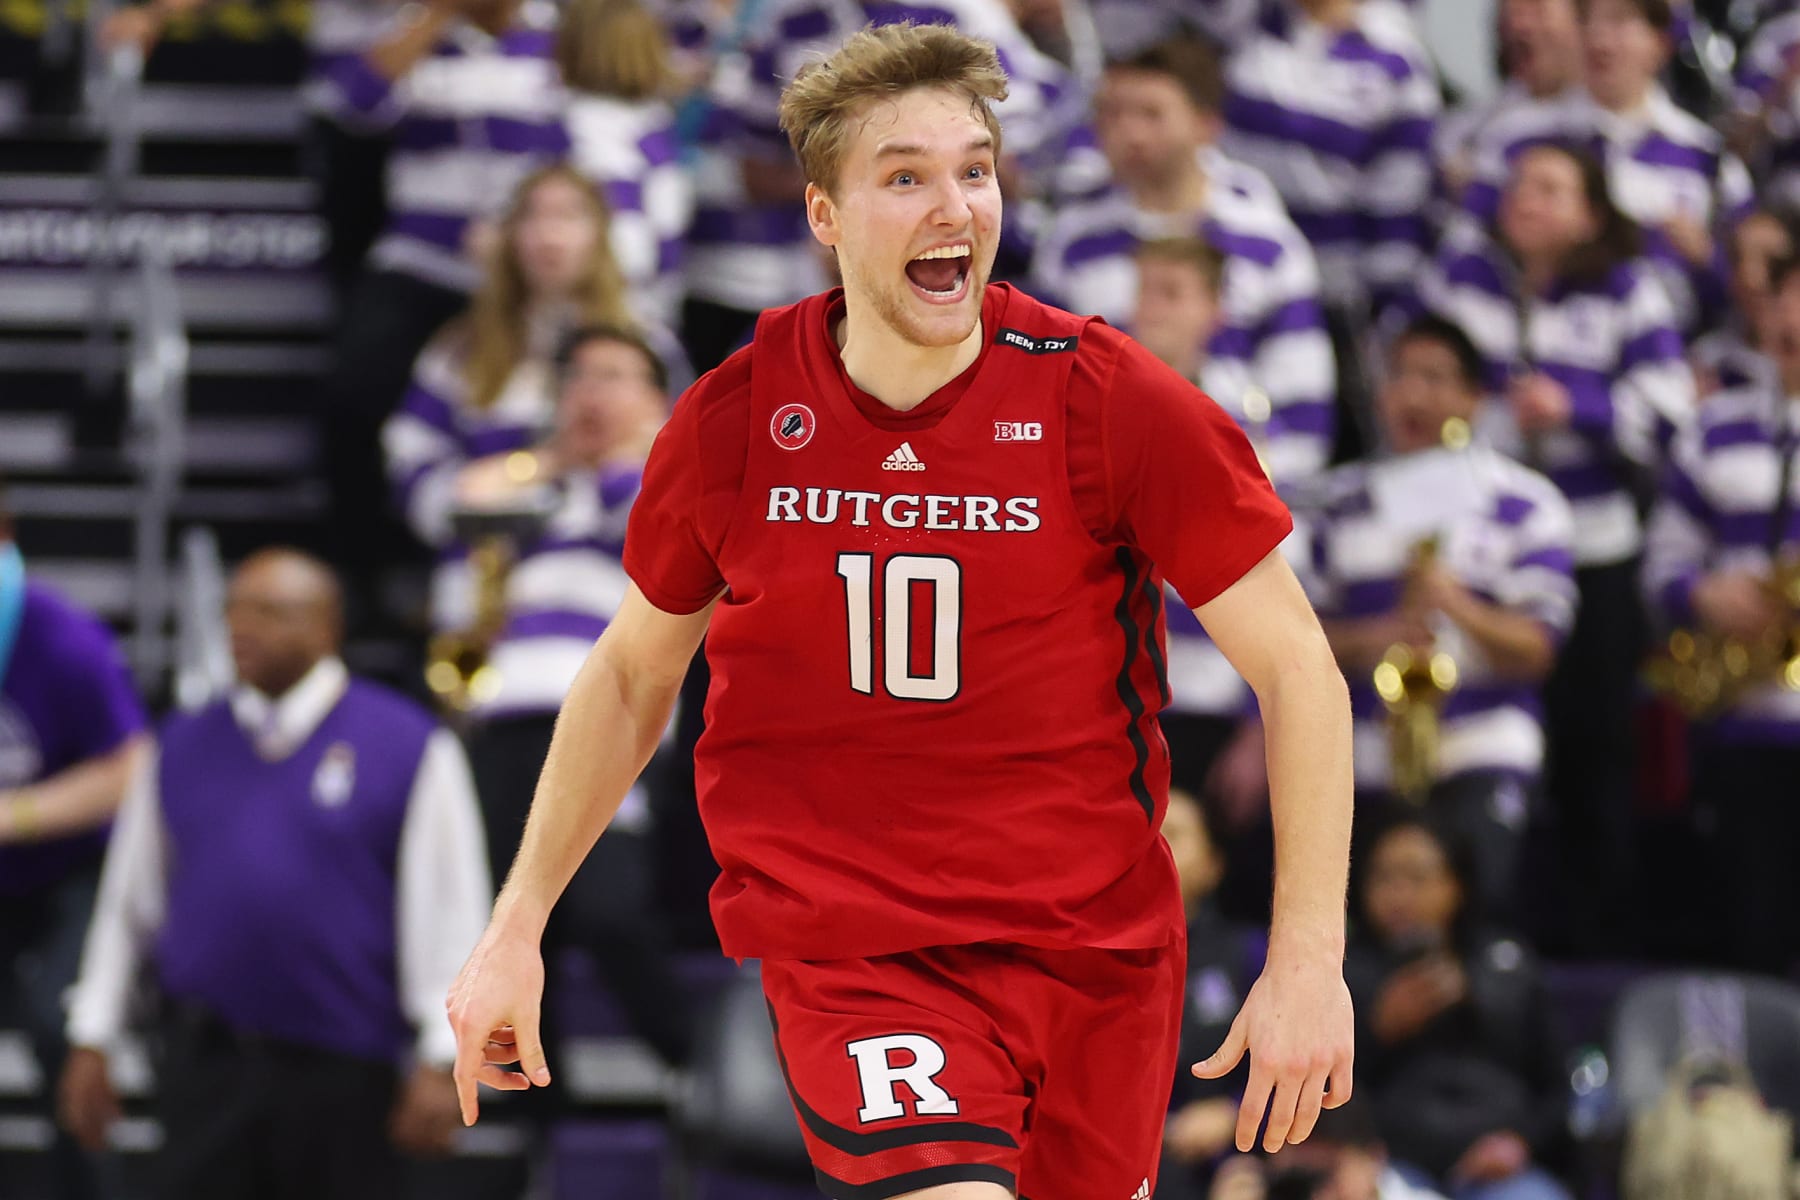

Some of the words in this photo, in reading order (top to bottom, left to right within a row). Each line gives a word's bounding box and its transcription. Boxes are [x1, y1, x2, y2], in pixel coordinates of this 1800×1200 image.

[1005, 332, 1034, 350] REM
[881, 460, 926, 471] adidas
[765, 486, 1041, 532] RUTGERS
[836, 552, 961, 702] 10
[846, 1033, 959, 1124] R
